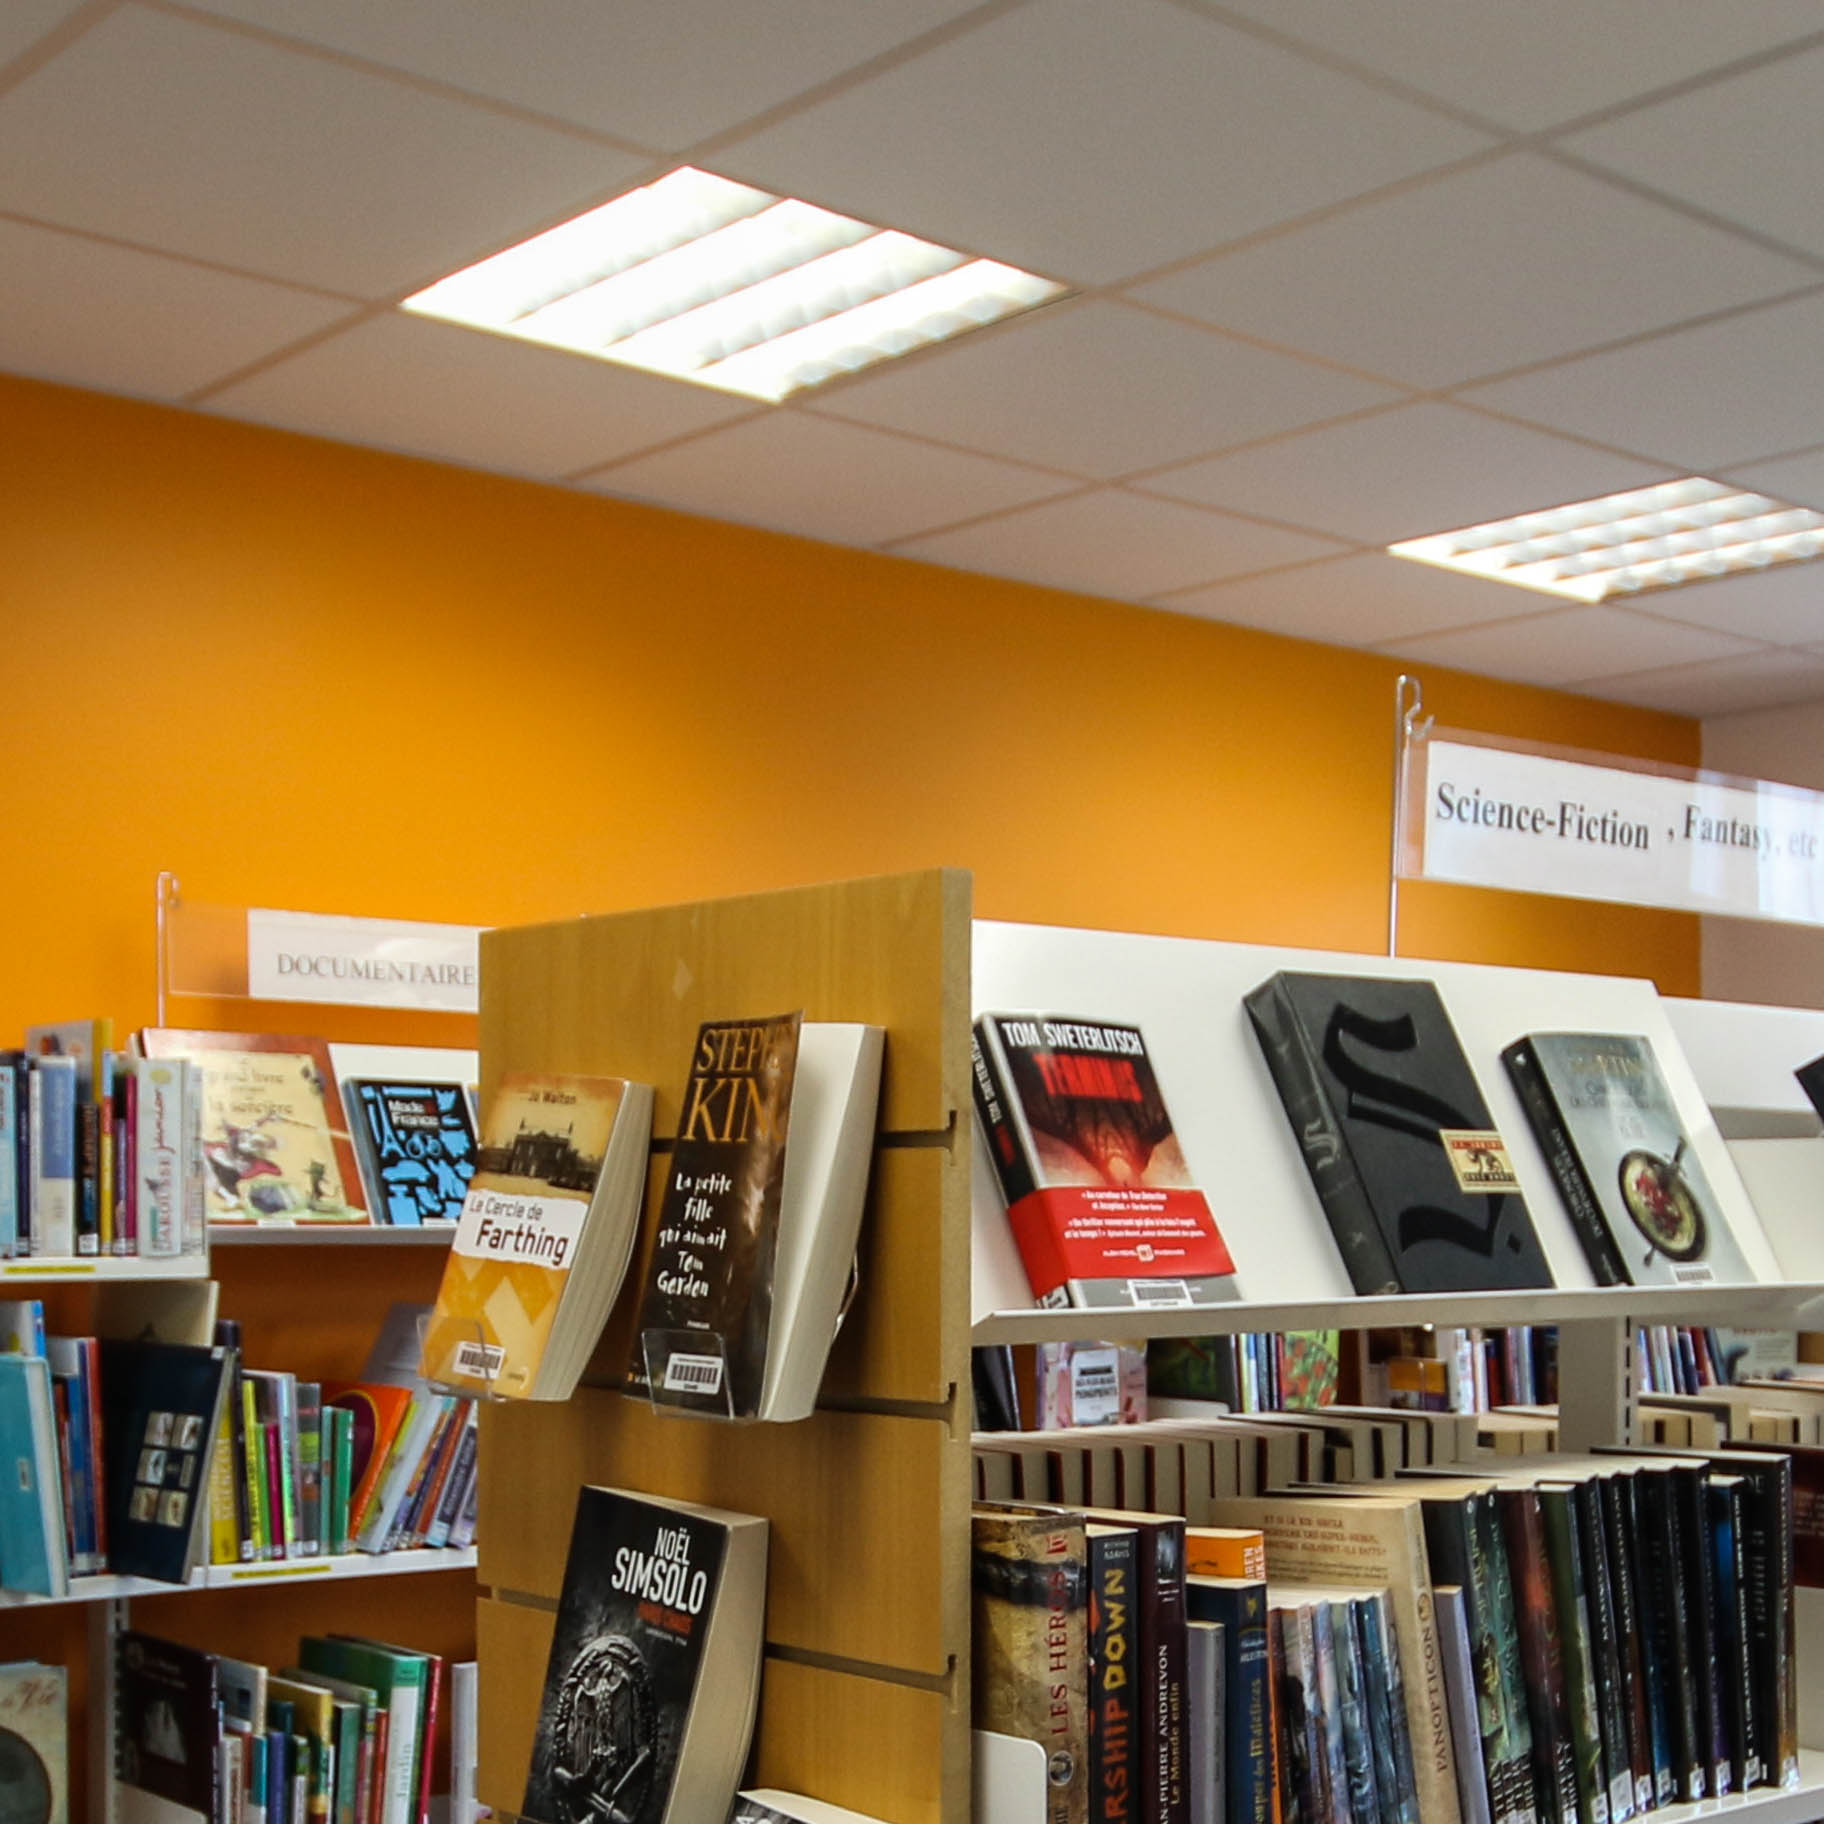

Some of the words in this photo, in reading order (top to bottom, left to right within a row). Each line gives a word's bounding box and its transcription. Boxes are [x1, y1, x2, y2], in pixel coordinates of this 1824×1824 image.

[1436, 781, 1650, 851] Science-Fiction
[1002, 1022, 1041, 1047] TOM
[1044, 1022, 1144, 1056] SWETERLITSCH
[387, 1098, 425, 1113] Made
[543, 1091, 576, 1106] Walton
[390, 1111, 440, 1127] France
[676, 1172, 692, 1191] La
[695, 1173, 733, 1199] petite
[484, 1197, 526, 1219] Cercle
[527, 1203, 544, 1221] de
[684, 1197, 714, 1221] fille
[476, 1219, 569, 1266] Farthing
[659, 1225, 681, 1248] qui
[683, 1226, 727, 1251] aimait
[678, 1250, 704, 1271] Tom
[654, 1526, 692, 1567] NOËL
[610, 1546, 708, 1615] SIMSOLO
[1046, 1570, 1071, 1673] HÉROS
[1101, 1568, 1128, 1698] DOWN
[1157, 1644, 1171, 1736] ANDREVON
[1169, 1682, 1181, 1720] enfin
[1420, 1627, 1450, 1773] PANOPTICON
[1048, 1683, 1070, 1736] LES
[1170, 1724, 1181, 1781] Monde
[1170, 1786, 1181, 1806] Le
